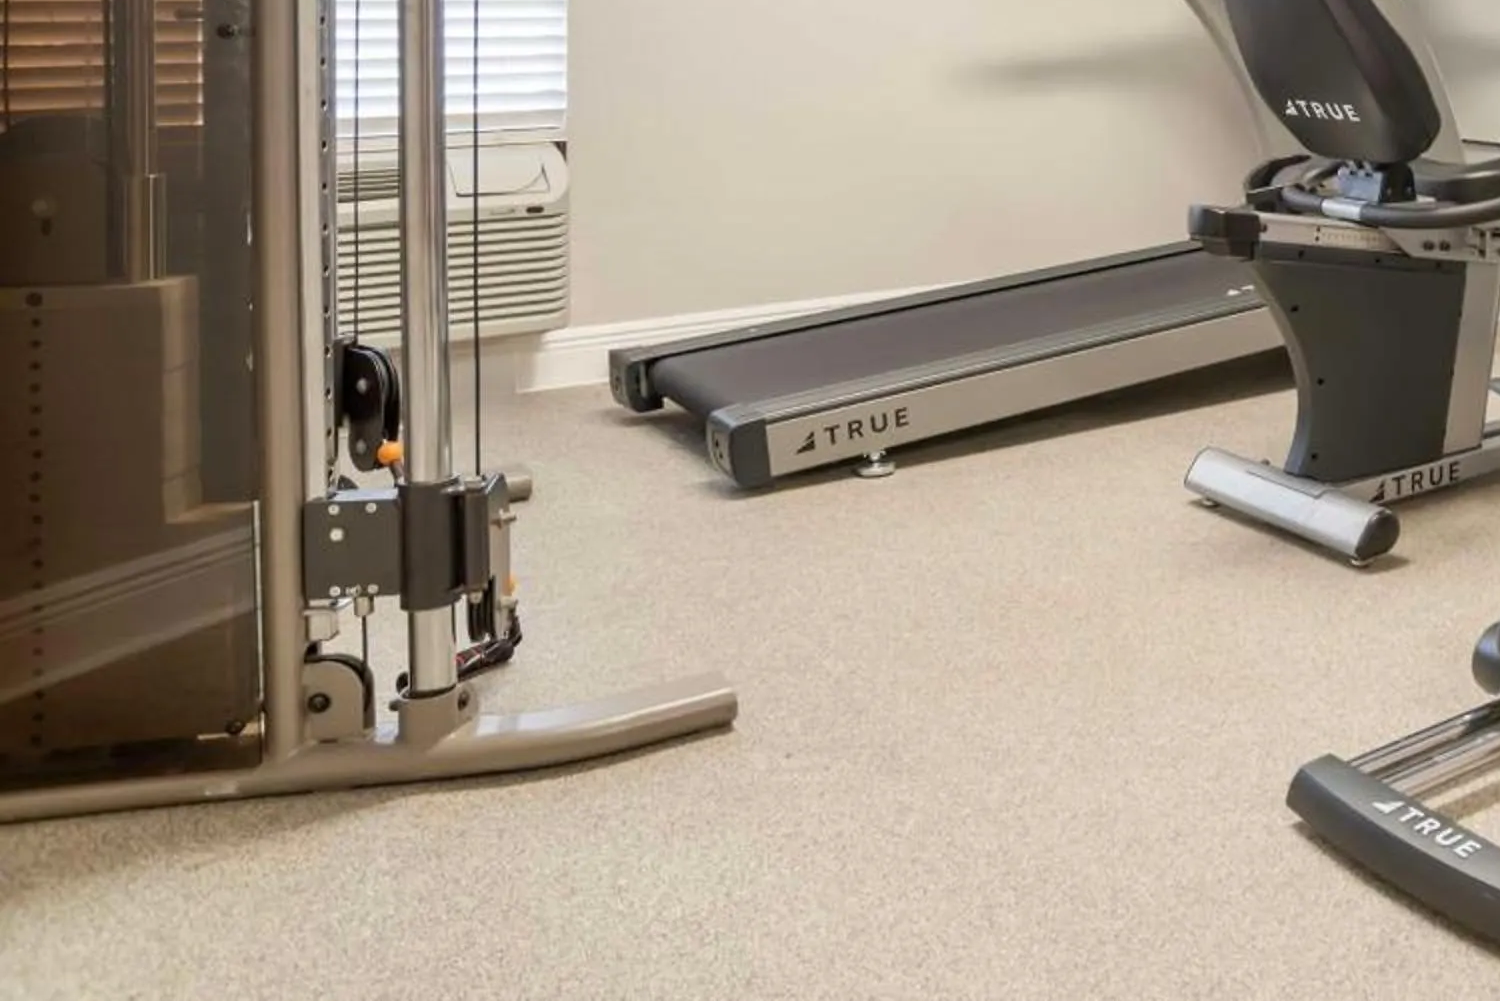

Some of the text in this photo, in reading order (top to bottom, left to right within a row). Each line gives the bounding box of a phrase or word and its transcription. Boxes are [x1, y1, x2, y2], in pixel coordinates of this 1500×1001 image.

[1295, 100, 1360, 121] TRUE
[824, 407, 909, 445] TRUE
[1392, 461, 1460, 495] TRUE
[1400, 806, 1482, 858] TRUE
